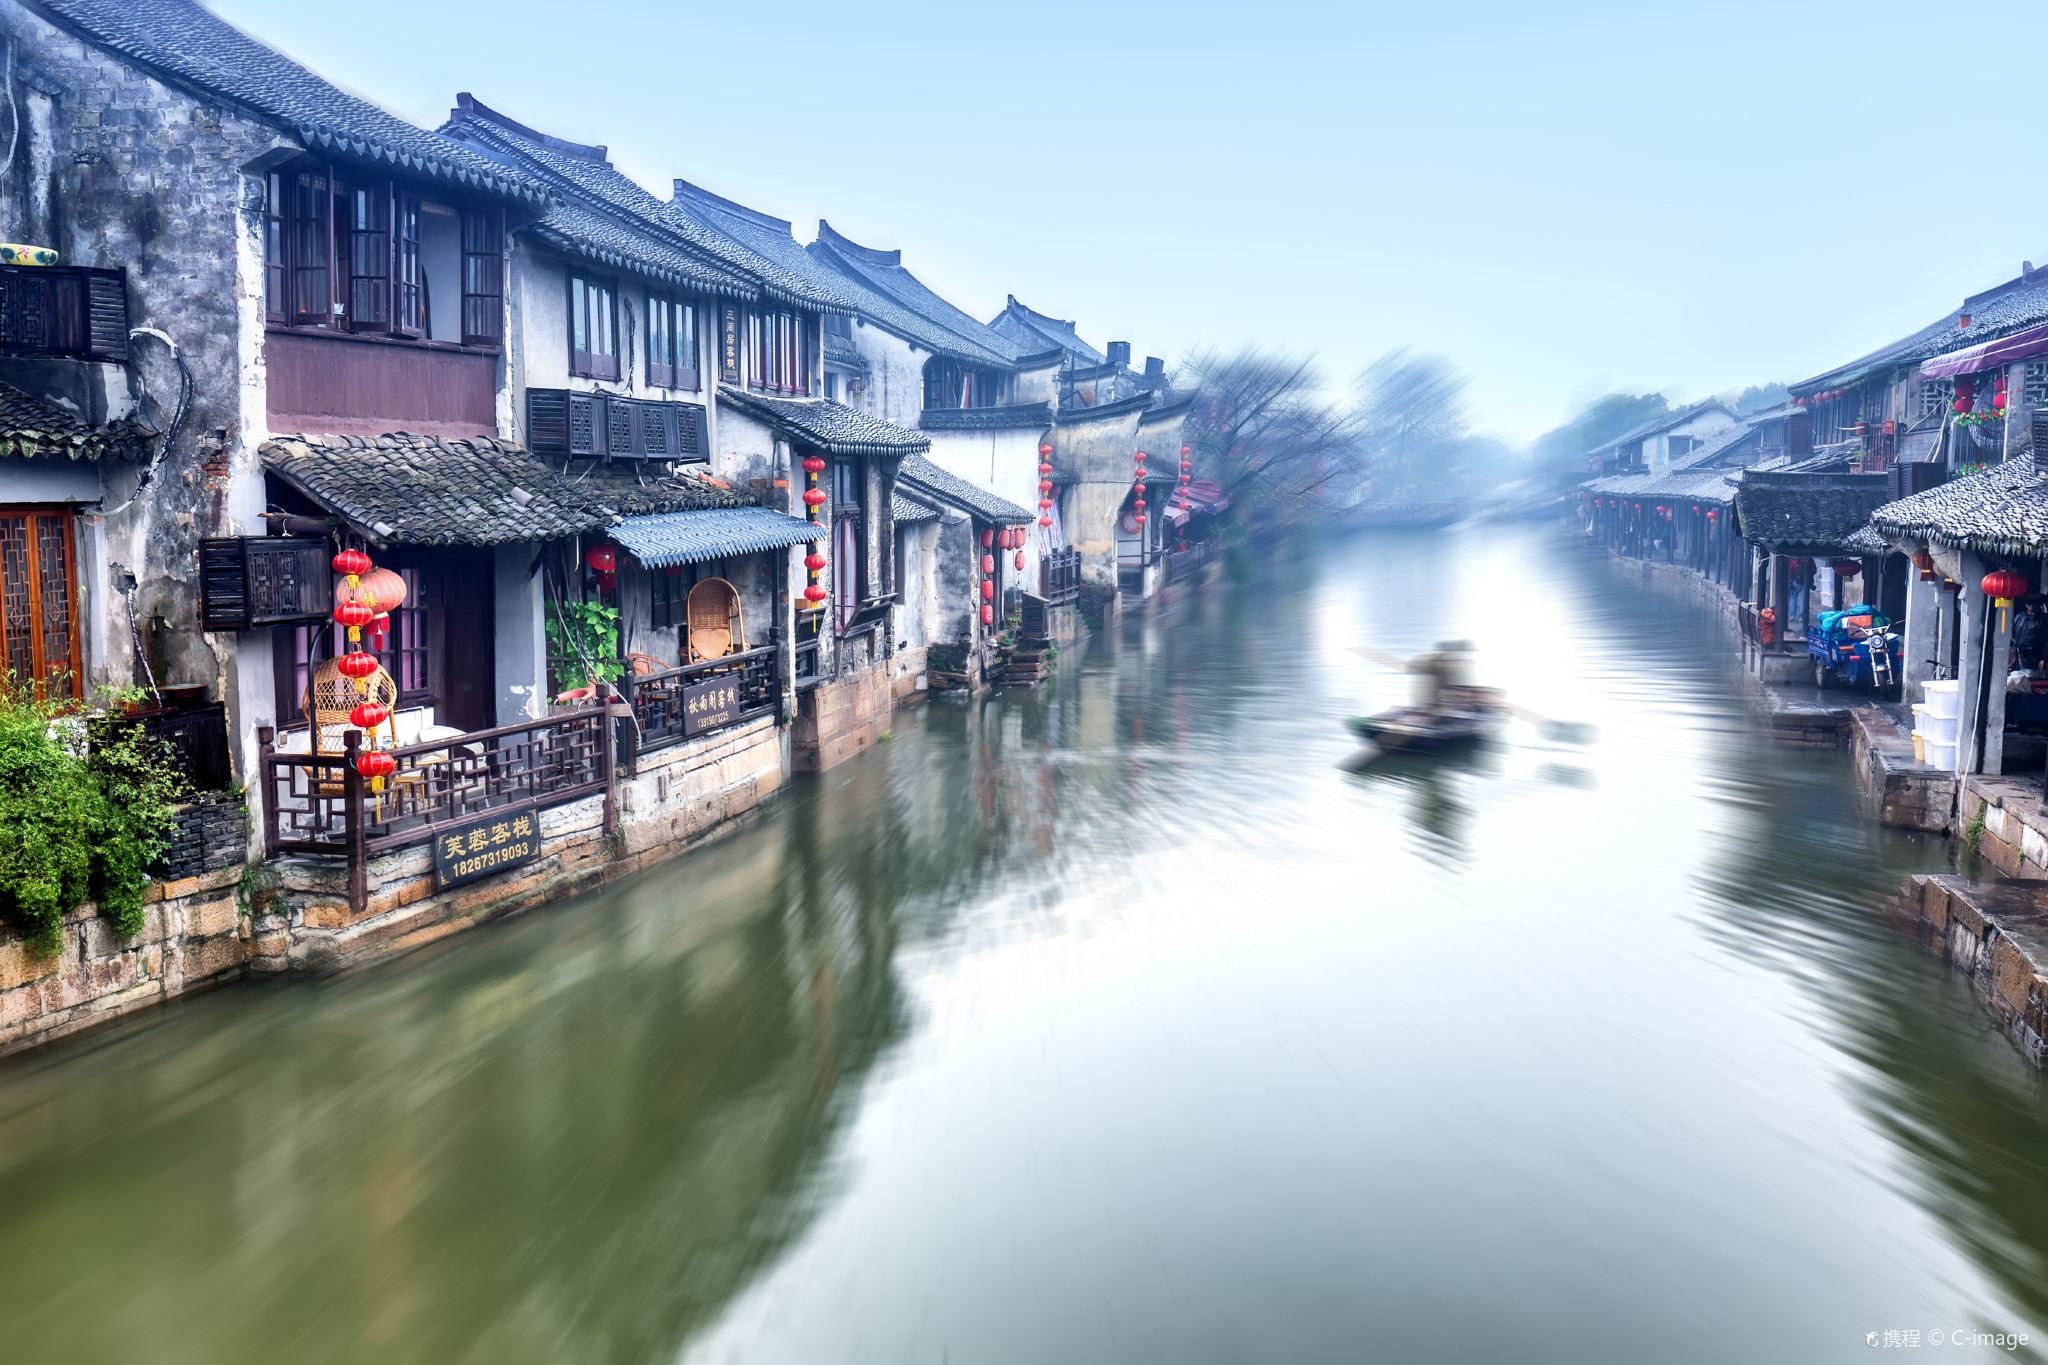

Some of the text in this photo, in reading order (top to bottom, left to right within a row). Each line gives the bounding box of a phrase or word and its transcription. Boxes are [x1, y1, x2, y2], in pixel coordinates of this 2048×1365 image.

[444, 815, 532, 859] 芙蓉客栈
[453, 842, 529, 878] 18267319093
